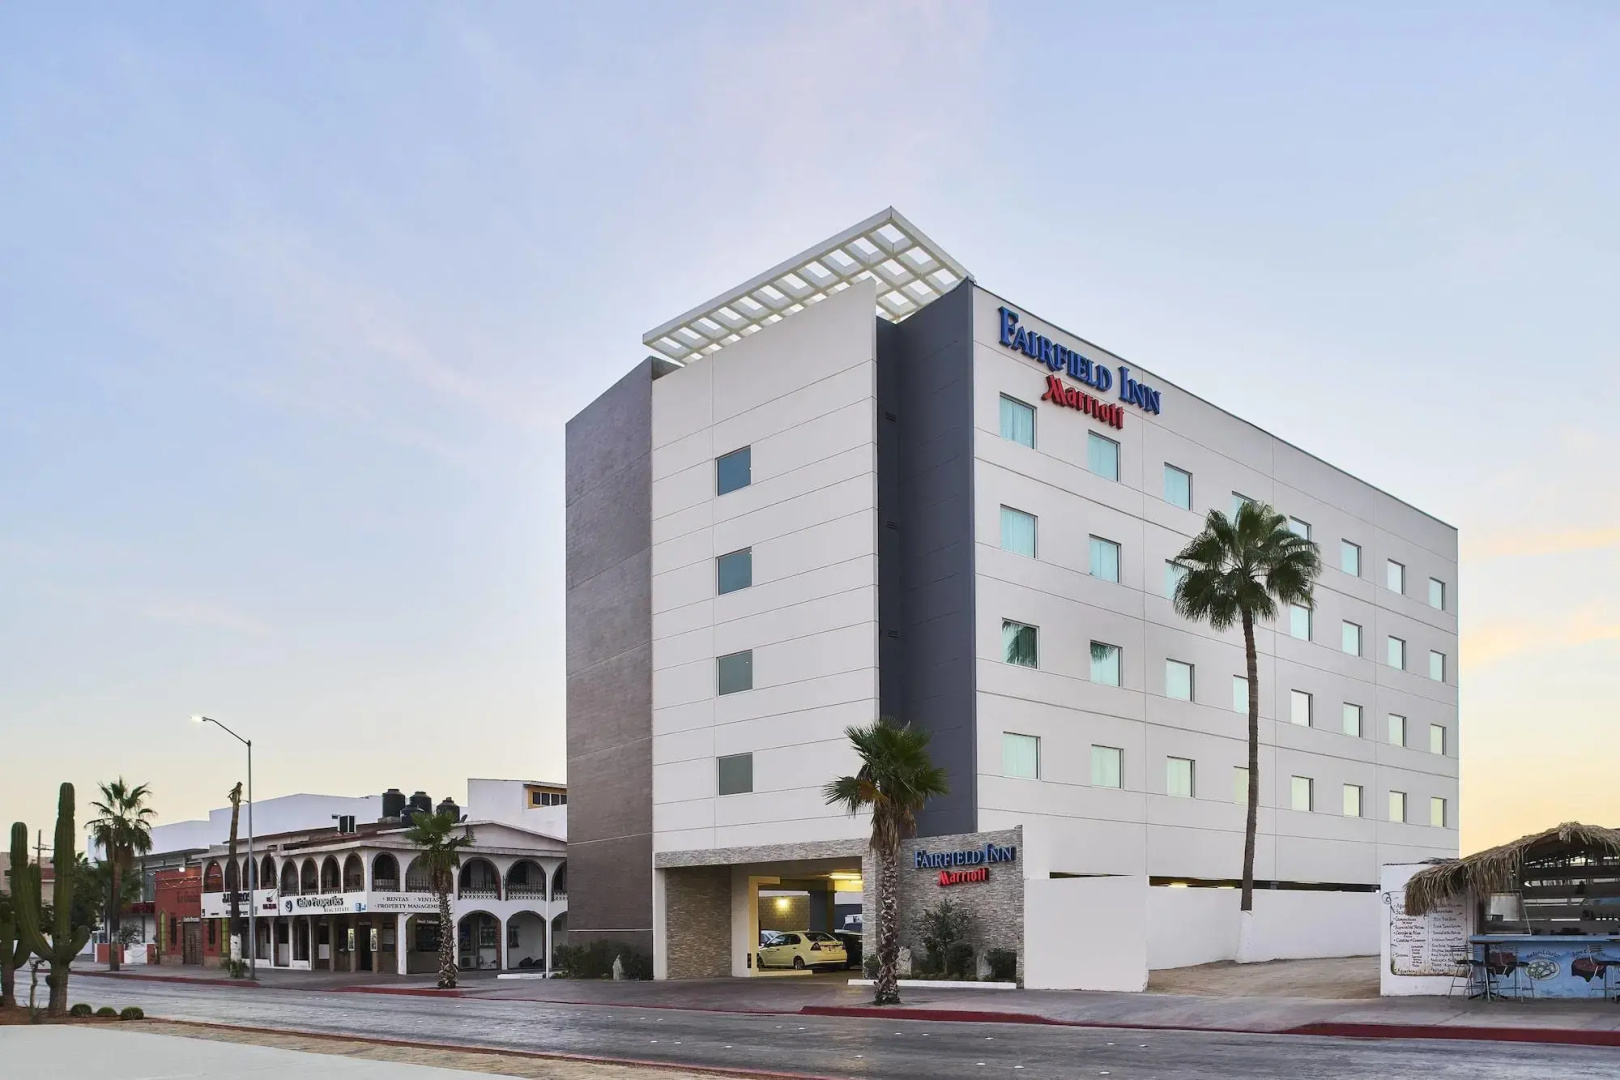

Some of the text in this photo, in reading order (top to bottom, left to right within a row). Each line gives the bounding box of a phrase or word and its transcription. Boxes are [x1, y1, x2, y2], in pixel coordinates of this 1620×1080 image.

[998, 306, 1161, 415] FAIRFIELD INN
[1041, 374, 1124, 429] Marriott
[914, 843, 1016, 868] FAIRFIELD INN
[937, 867, 989, 887] Marriott
